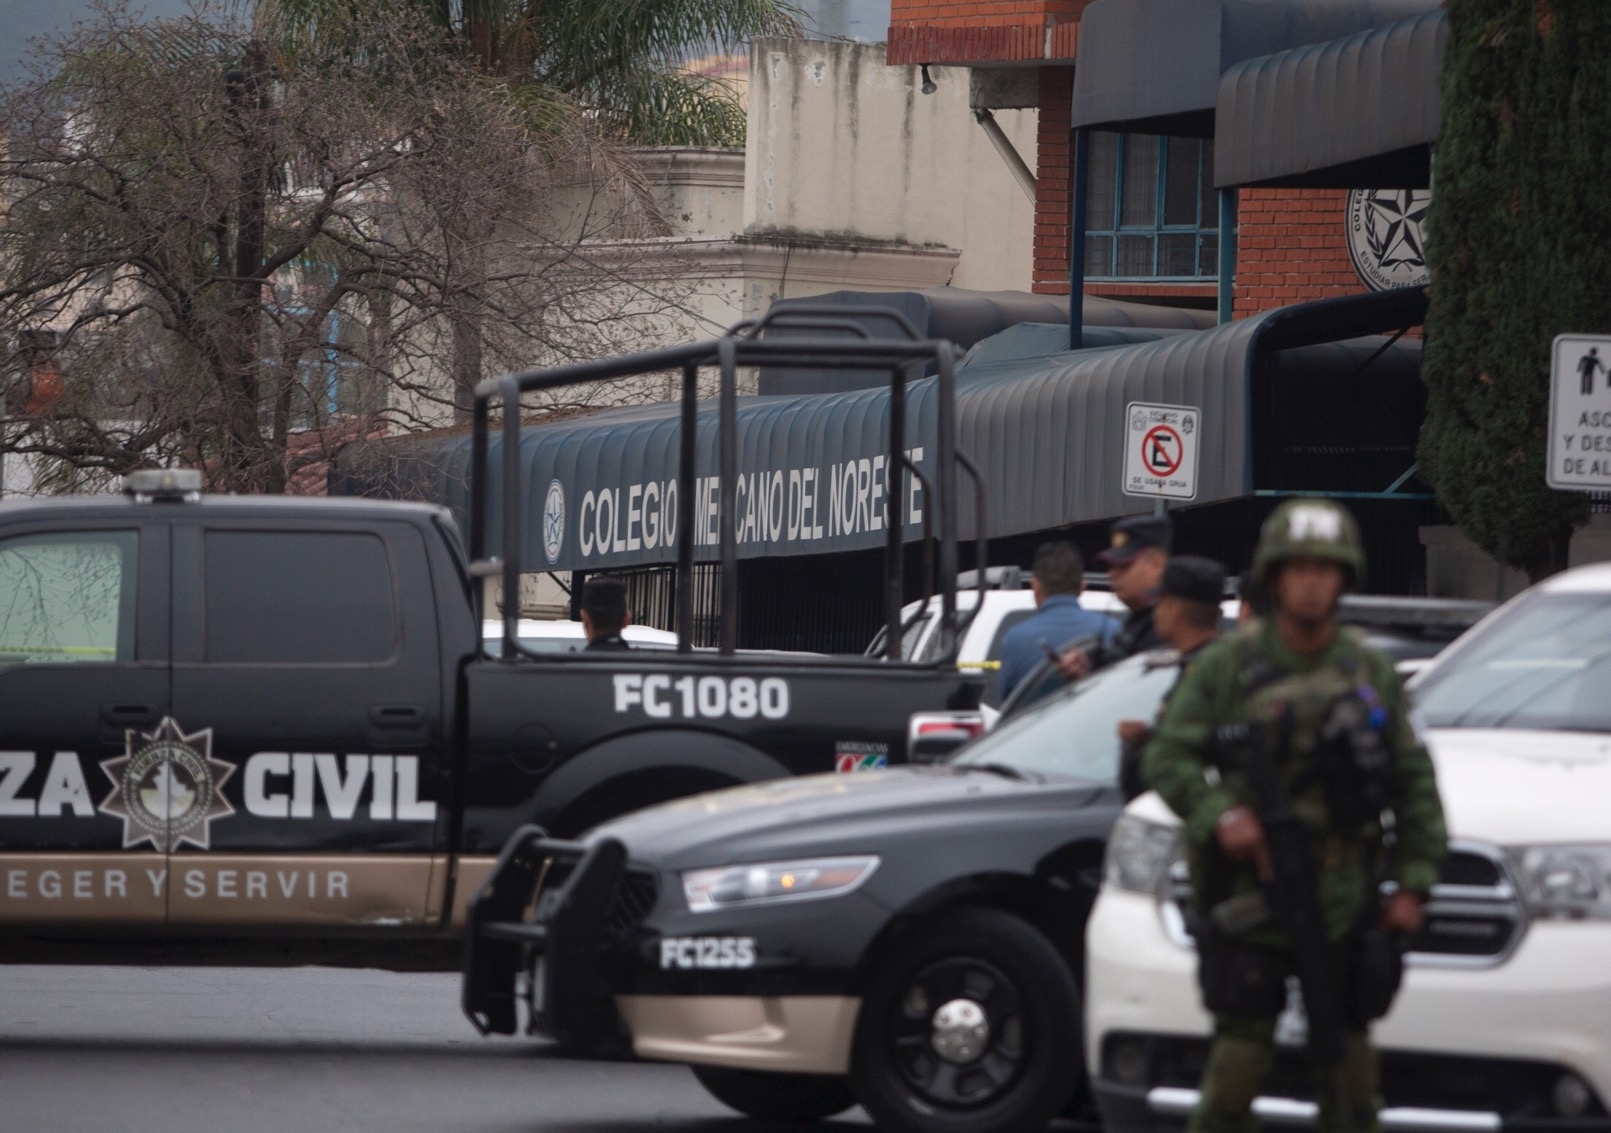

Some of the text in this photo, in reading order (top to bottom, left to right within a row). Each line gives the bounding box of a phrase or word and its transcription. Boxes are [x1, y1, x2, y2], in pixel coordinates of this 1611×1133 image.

[1360, 250, 1391, 288] ESTUDIAR
[1412, 274, 1427, 286] SER
[1578, 411, 1611, 428] ASC
[1562, 434, 1575, 449] Y
[1563, 458, 1585, 475] DE
[579, 478, 677, 557] COLEGIO
[681, 469, 784, 545] MECANO
[787, 467, 823, 541] DEL
[613, 674, 789, 719] FC1080
[0, 751, 95, 816] ZA
[243, 752, 437, 820] CIVIL
[7, 869, 349, 898] EGER Y SERVIR
[661, 936, 756, 969] FC1255
